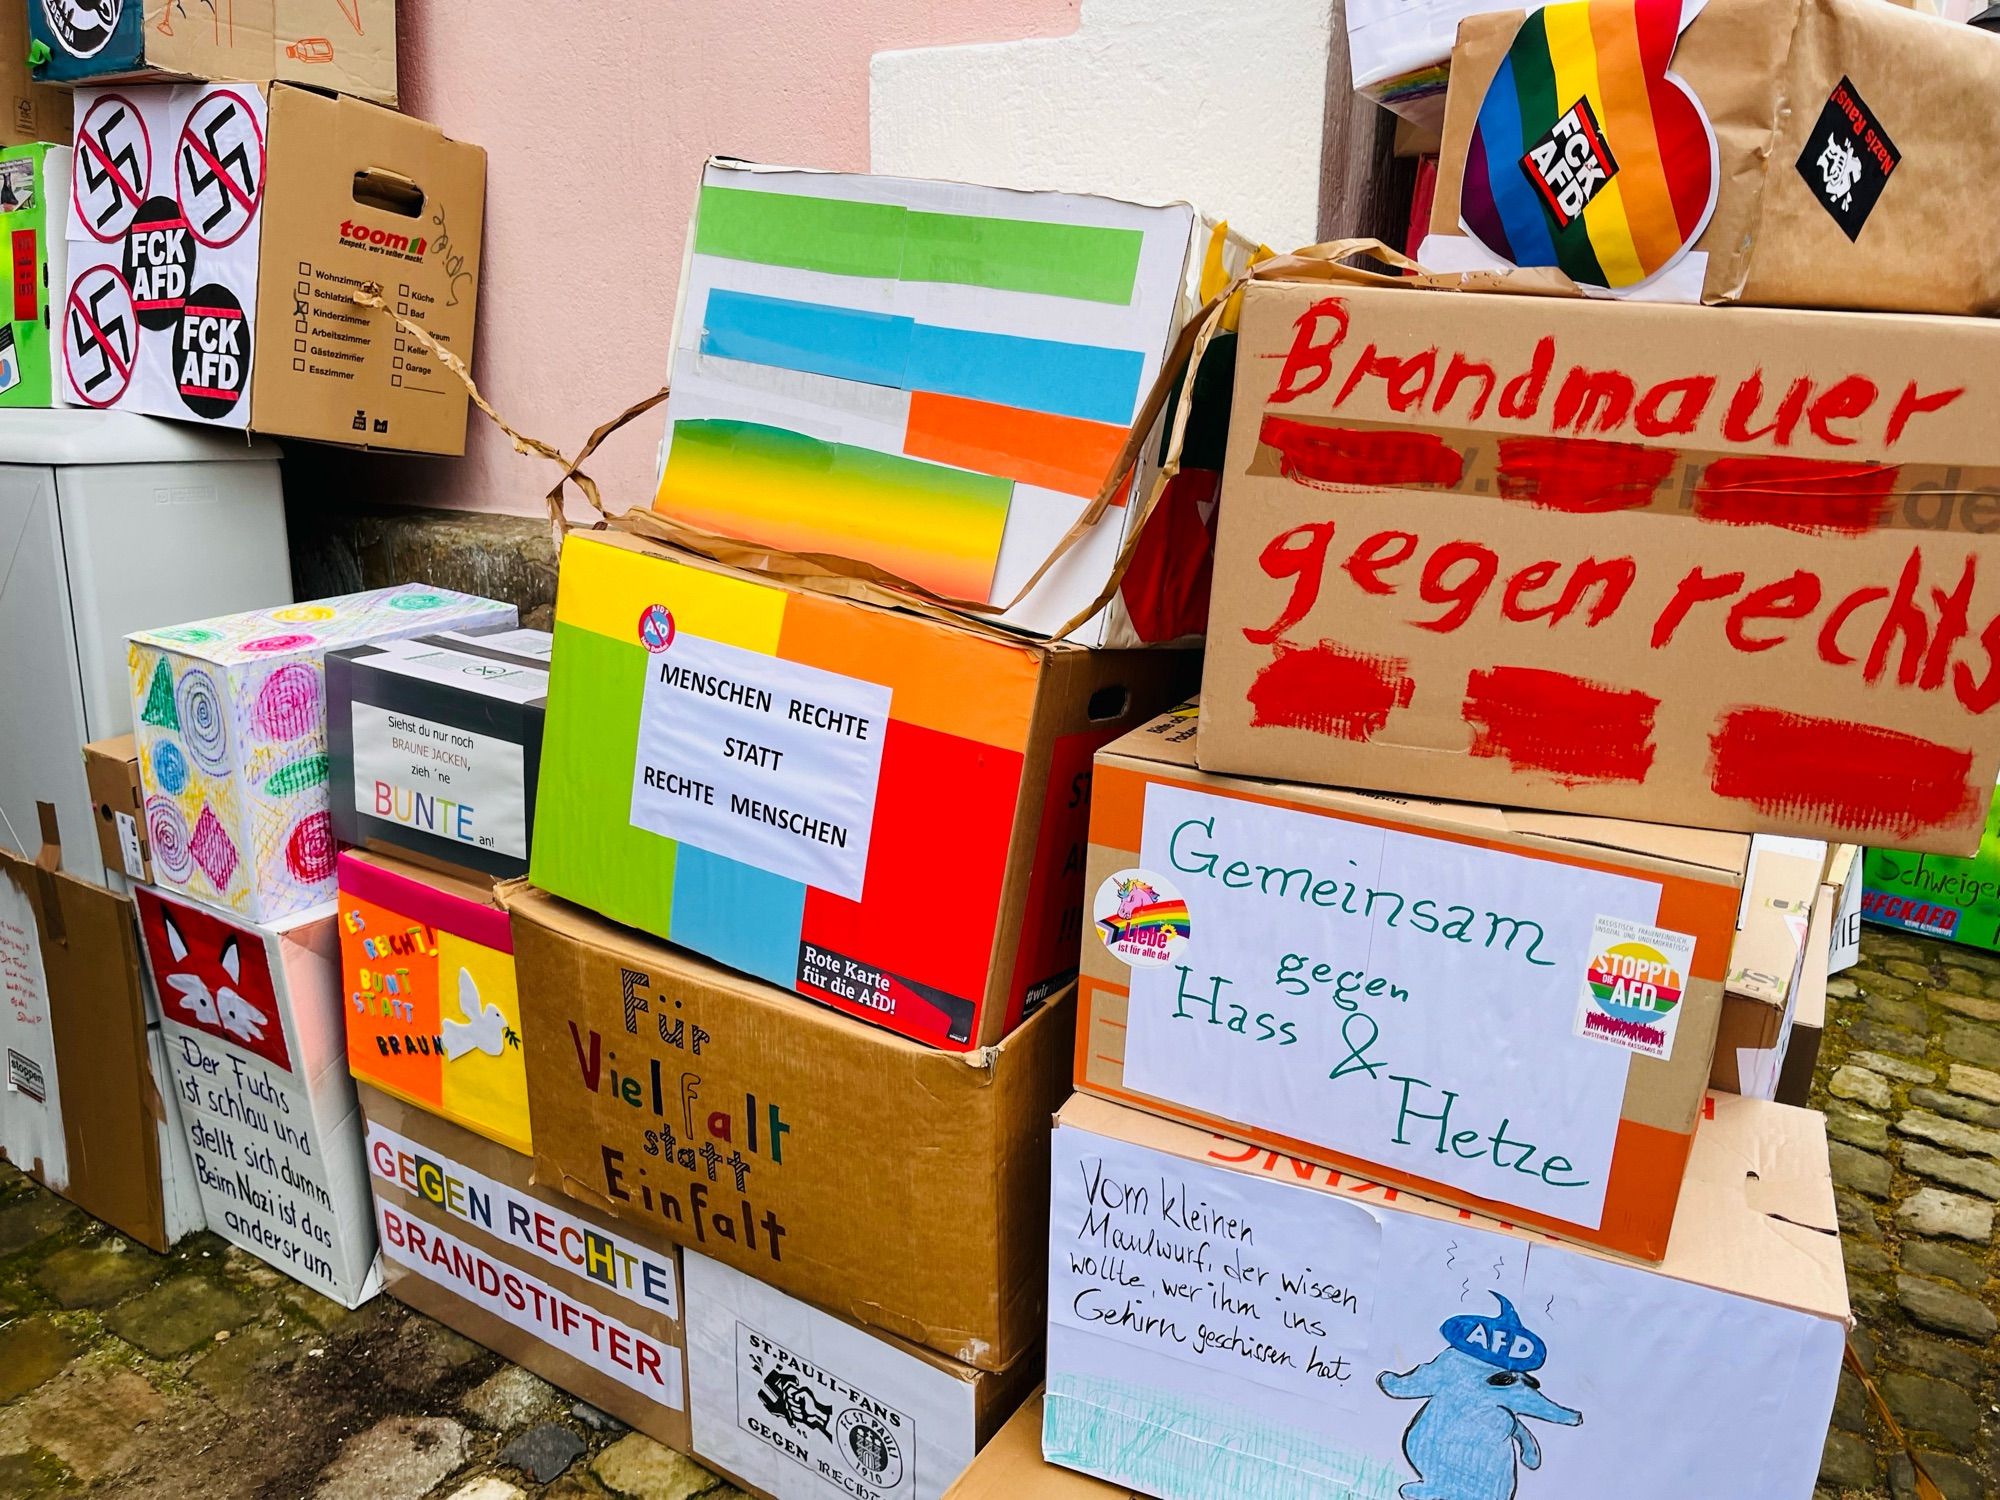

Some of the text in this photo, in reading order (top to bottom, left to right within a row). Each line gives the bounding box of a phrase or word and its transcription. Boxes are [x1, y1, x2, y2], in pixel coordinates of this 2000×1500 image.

[1830, 85, 1895, 176] Nazis Raus!
[1552, 108, 1607, 202] FCK
[1527, 140, 1584, 219] AFD
[131, 228, 187, 268] FCK
[340, 219, 409, 251] toom
[132, 264, 186, 301] AFD
[411, 291, 435, 304] Küche
[313, 308, 371, 327] Kinderzimmer
[410, 309, 425, 319] Bad
[182, 315, 241, 356] FCK
[310, 346, 365, 363] Gästezimmer
[311, 327, 372, 346] Arbeitszimmer
[407, 345, 429, 357] Keller
[180, 351, 240, 390] AFD
[309, 364, 355, 380] Esszimmer
[405, 362, 432, 376] Garage
[1262, 297, 1965, 449] Brandmauer
[1242, 520, 2000, 714] gegen rechts
[659, 663, 870, 741] MENSCHEN RECHTE
[387, 714, 475, 749] Siehst du nur noch
[391, 735, 472, 771] BRAUNE JACKEN,
[411, 763, 431, 779] zieh
[722, 736, 784, 772] STATT
[374, 780, 475, 842] BUNTE
[643, 766, 848, 850] RECHTE MENSCHEN
[478, 834, 495, 848] an!
[1168, 816, 1555, 967] Gemeinsam
[1874, 850, 2000, 908] Schweige
[344, 909, 366, 935] ES
[1862, 891, 1958, 930] #FCKAFD
[364, 926, 440, 960] REICHT!
[1118, 943, 1171, 961] ist für alle da!
[1123, 922, 1168, 949] Liebe
[1623, 931, 1635, 941] UND
[360, 967, 412, 996] BUNT
[804, 945, 891, 993] Rote Karte
[1276, 953, 1410, 1013] gegen
[1596, 951, 1681, 988] STOPPT
[1601, 973, 1614, 985] DIE
[352, 993, 414, 1024] STATT
[802, 965, 897, 1016] für die AfD!
[1609, 978, 1658, 1012] AFD
[619, 967, 712, 1057] Für
[1172, 964, 1387, 1081] Hass &
[375, 1032, 444, 1057] BRAUN
[178, 1034, 291, 1114] Der Fuchs
[567, 1019, 791, 1166] Vielfalt
[178, 1068, 312, 1157] ist schlau und
[1388, 1073, 1591, 1188] Hetze
[191, 1118, 335, 1214] stellt sich dumm.
[643, 1123, 752, 1194] statt
[194, 1153, 334, 1250] Beim Nazi ist das
[601, 1144, 787, 1263] Einfalt
[1079, 1158, 1254, 1247] Vom kleinen
[373, 1140, 670, 1306] GEGEN RECHTE
[224, 1208, 338, 1287] andersrum.
[1078, 1207, 1358, 1314] Maulwurf, der wissen
[384, 1210, 665, 1387] BRANDSTIFTER
[1070, 1251, 1328, 1338] wollte, wer ihm ins
[1073, 1288, 1187, 1343] Gehirn
[1193, 1323, 1297, 1369] geschissen
[1465, 1322, 1535, 1360] AFD
[749, 1334, 901, 1428] ST.PAULI-FANS
[747, 1417, 886, 1500] GEGEN RECHT
[840, 1417, 854, 1432] FC
[871, 1420, 899, 1459] PAULI
[855, 1461, 883, 1485] 1910
